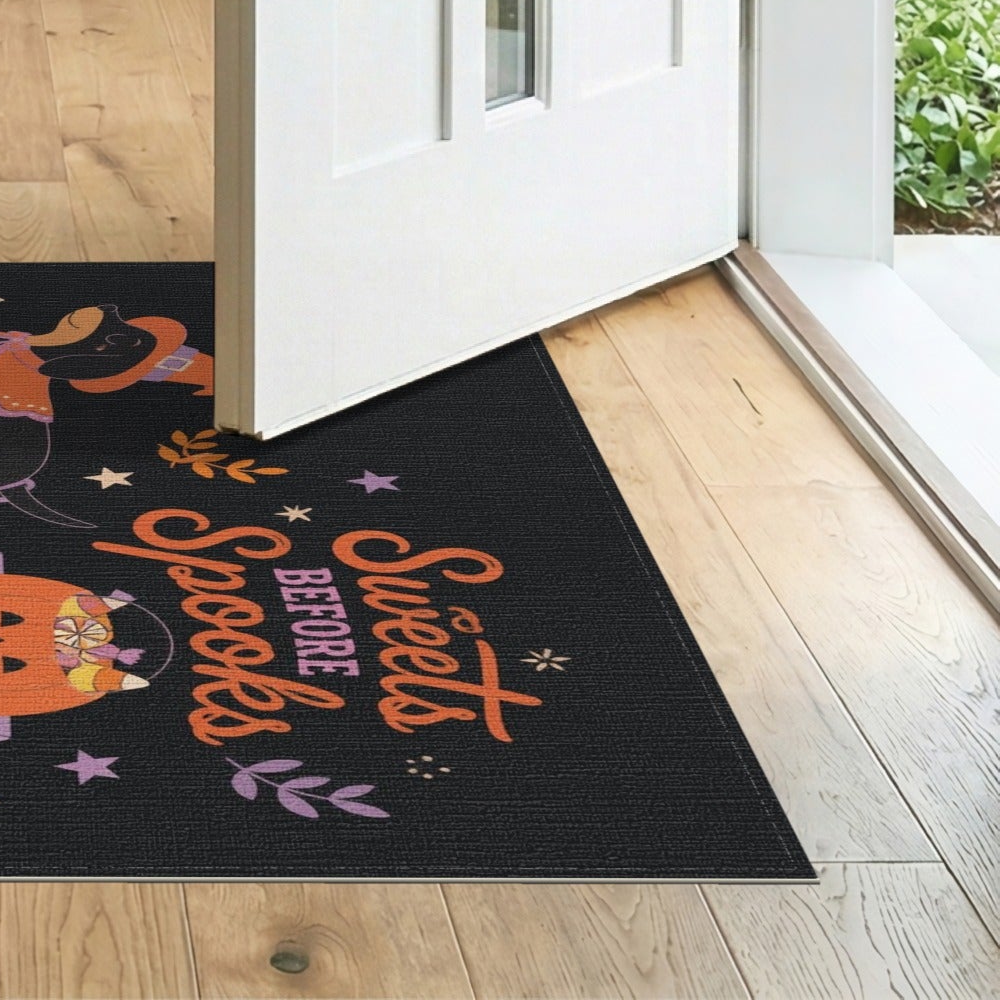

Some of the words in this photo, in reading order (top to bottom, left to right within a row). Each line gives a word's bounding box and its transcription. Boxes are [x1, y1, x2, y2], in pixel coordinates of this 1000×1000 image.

[92, 508, 346, 746] Spooks
[273, 567, 361, 677] BEFORE
[332, 530, 543, 742] Sweets
